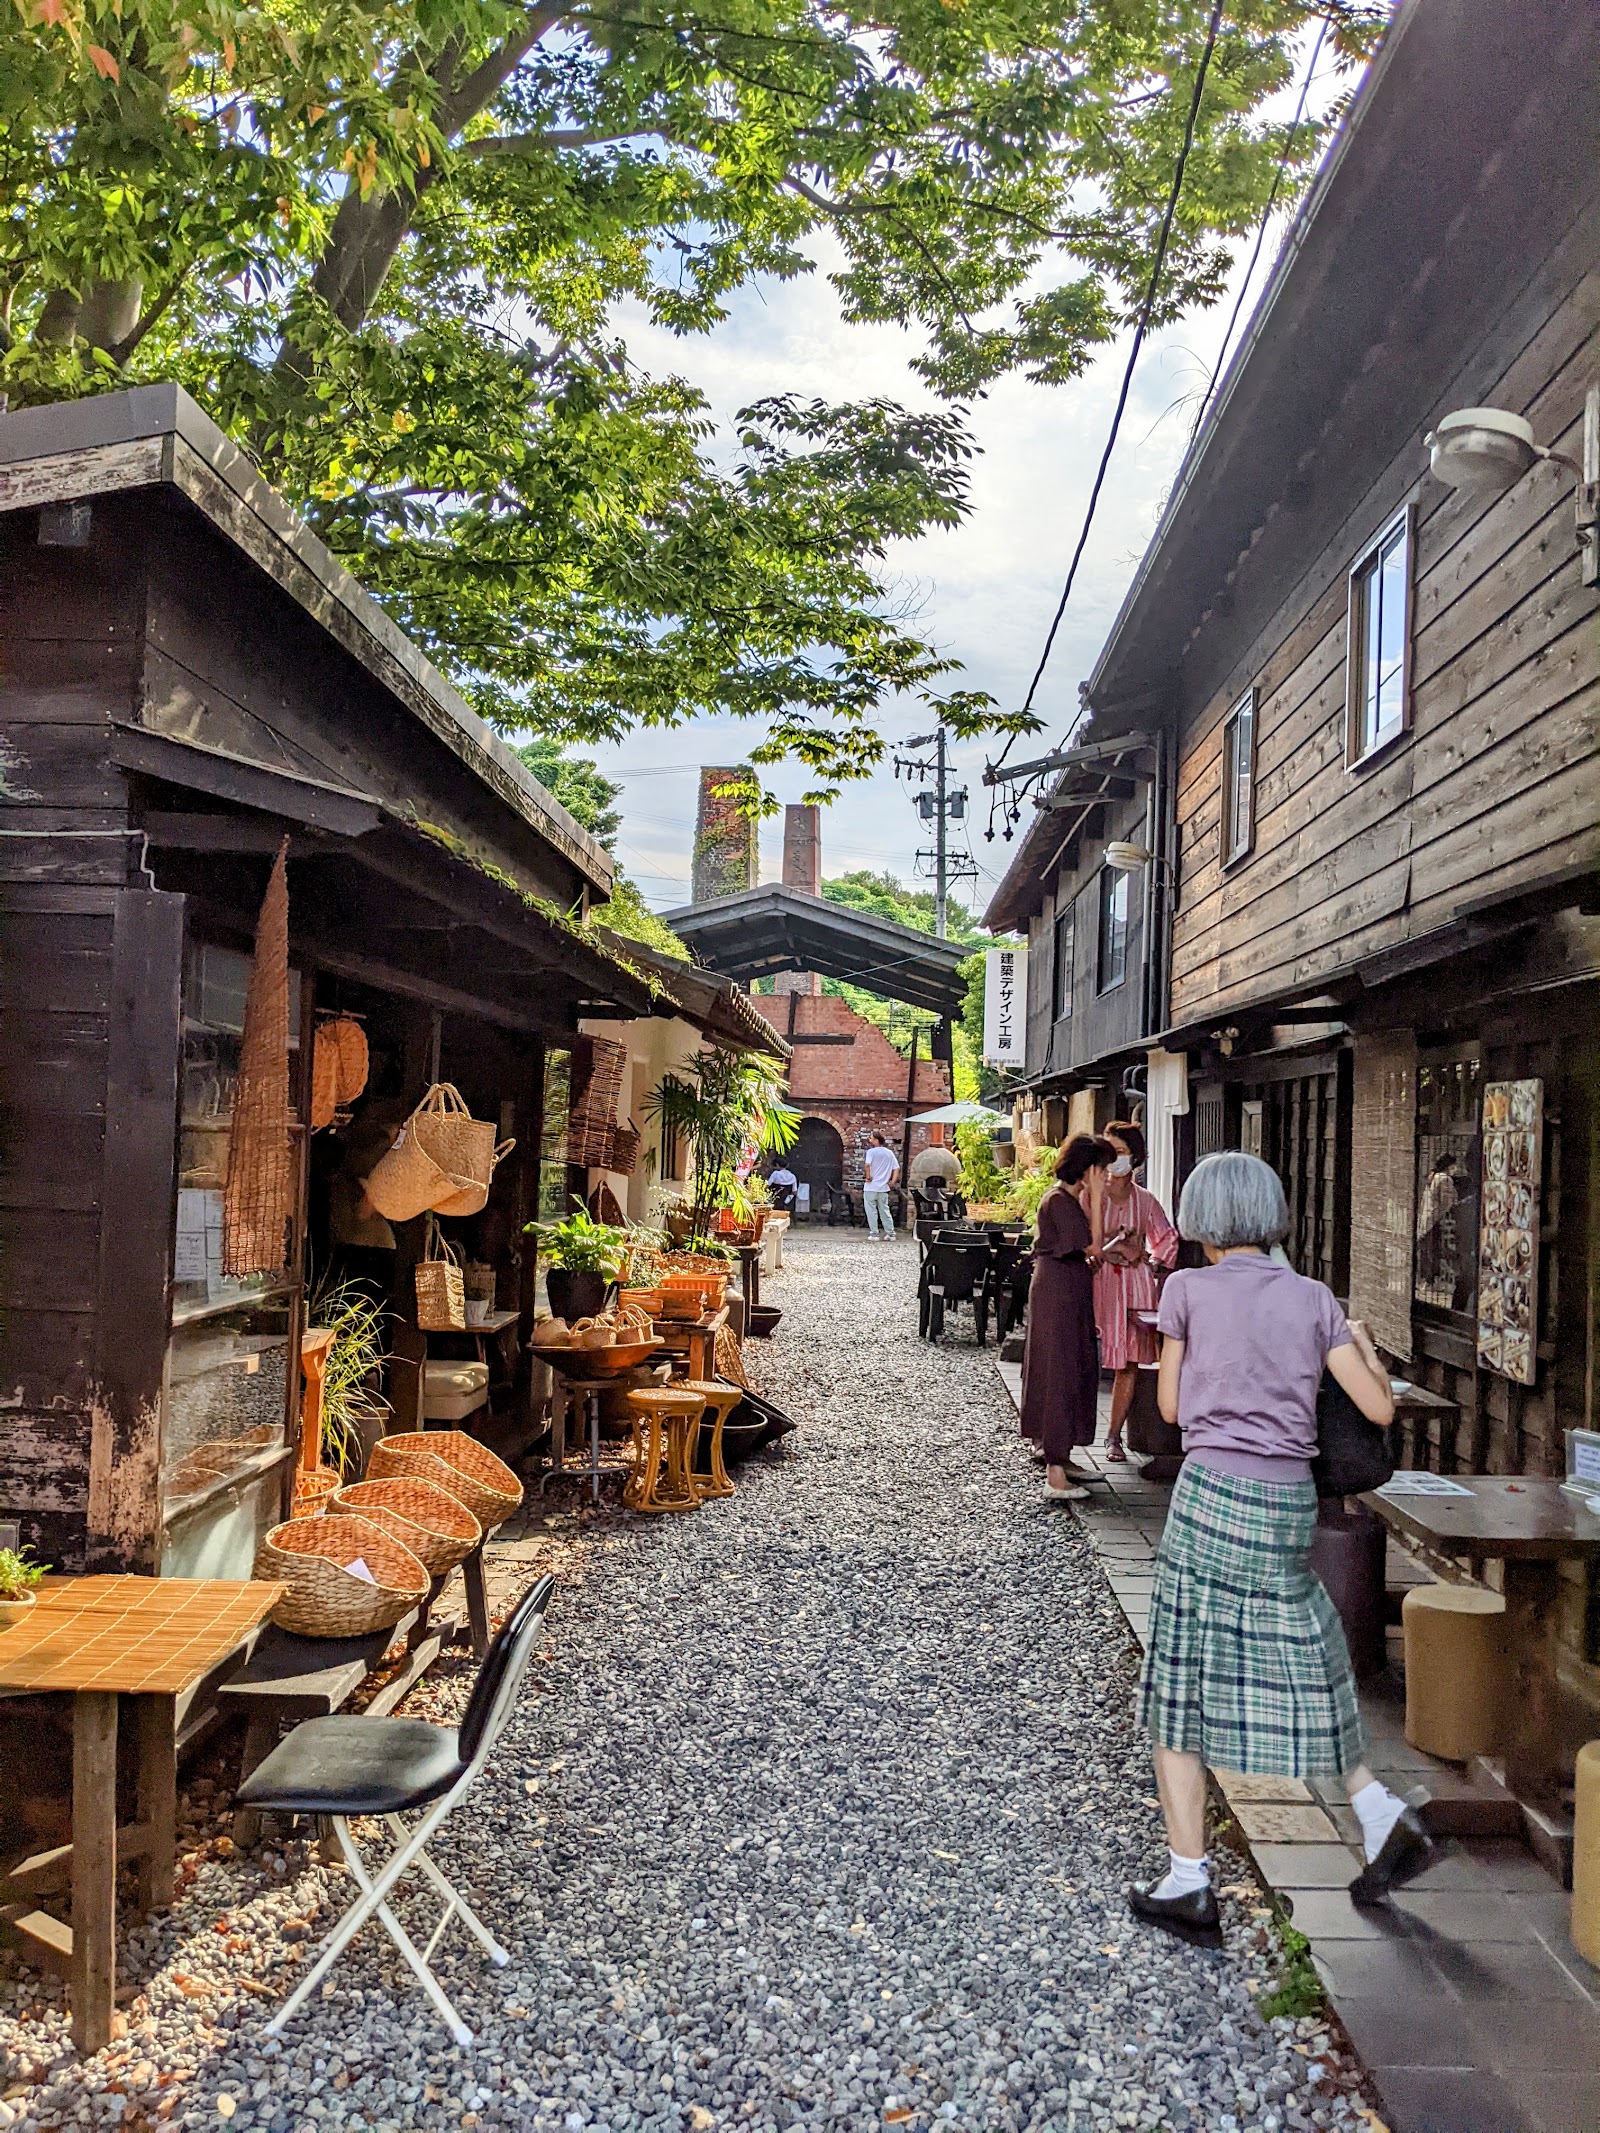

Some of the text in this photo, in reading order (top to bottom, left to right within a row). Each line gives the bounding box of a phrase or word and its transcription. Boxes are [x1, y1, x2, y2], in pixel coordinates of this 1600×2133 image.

[998, 952, 1014, 1050] 建築デザイン工房
